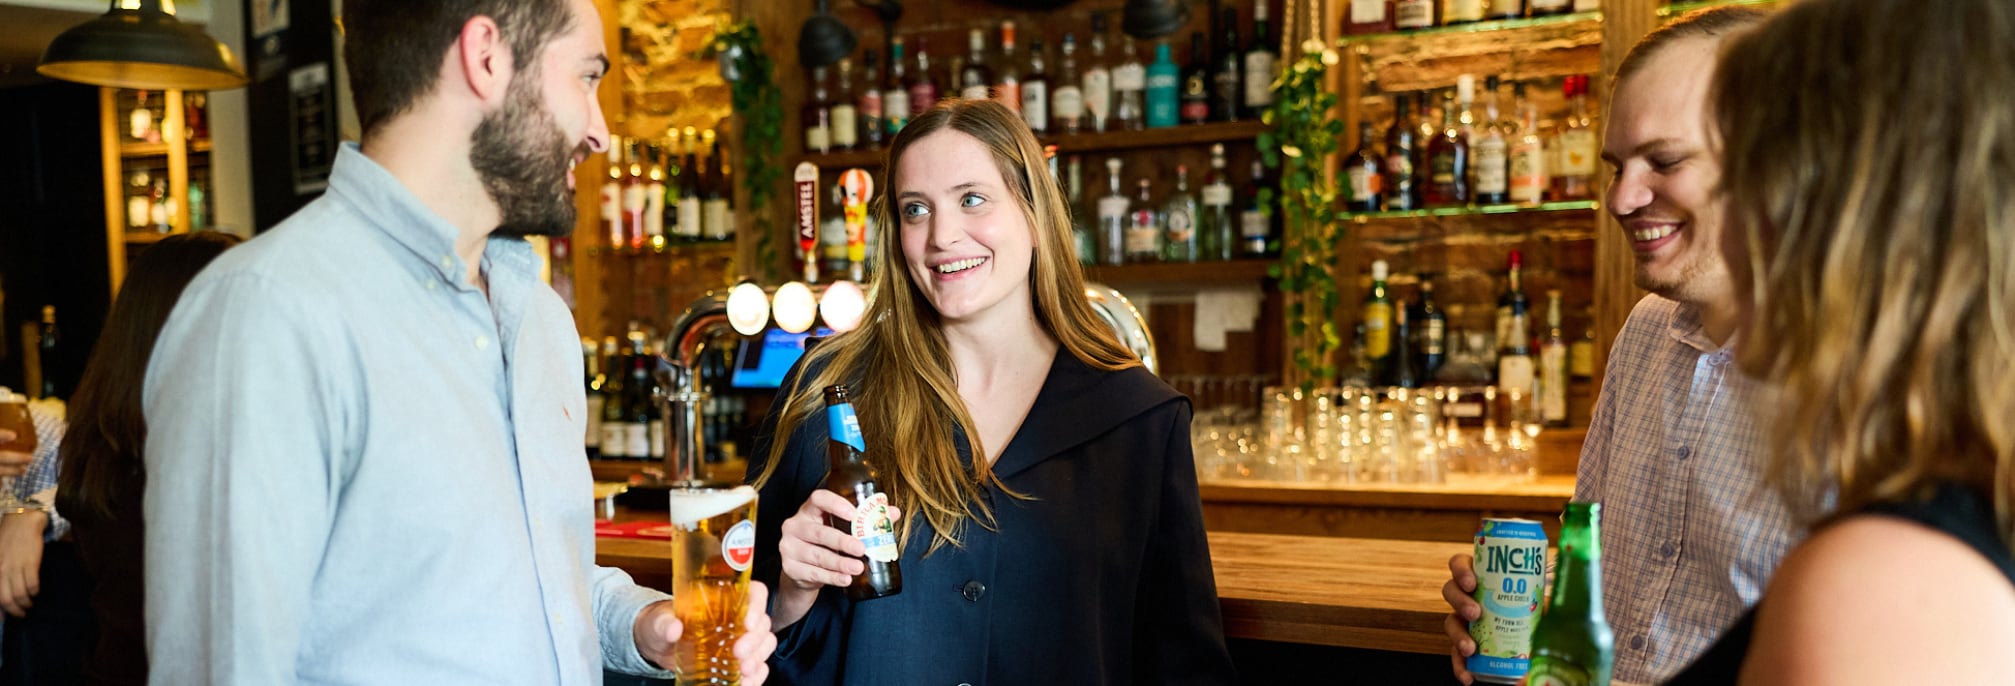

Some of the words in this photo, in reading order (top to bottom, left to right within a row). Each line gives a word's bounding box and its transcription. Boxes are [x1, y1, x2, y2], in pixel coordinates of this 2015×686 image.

[800, 183, 814, 238] AMSTEL
[1503, 577, 1527, 594] 0.0
[1489, 661, 1514, 670] ALCOHOL
